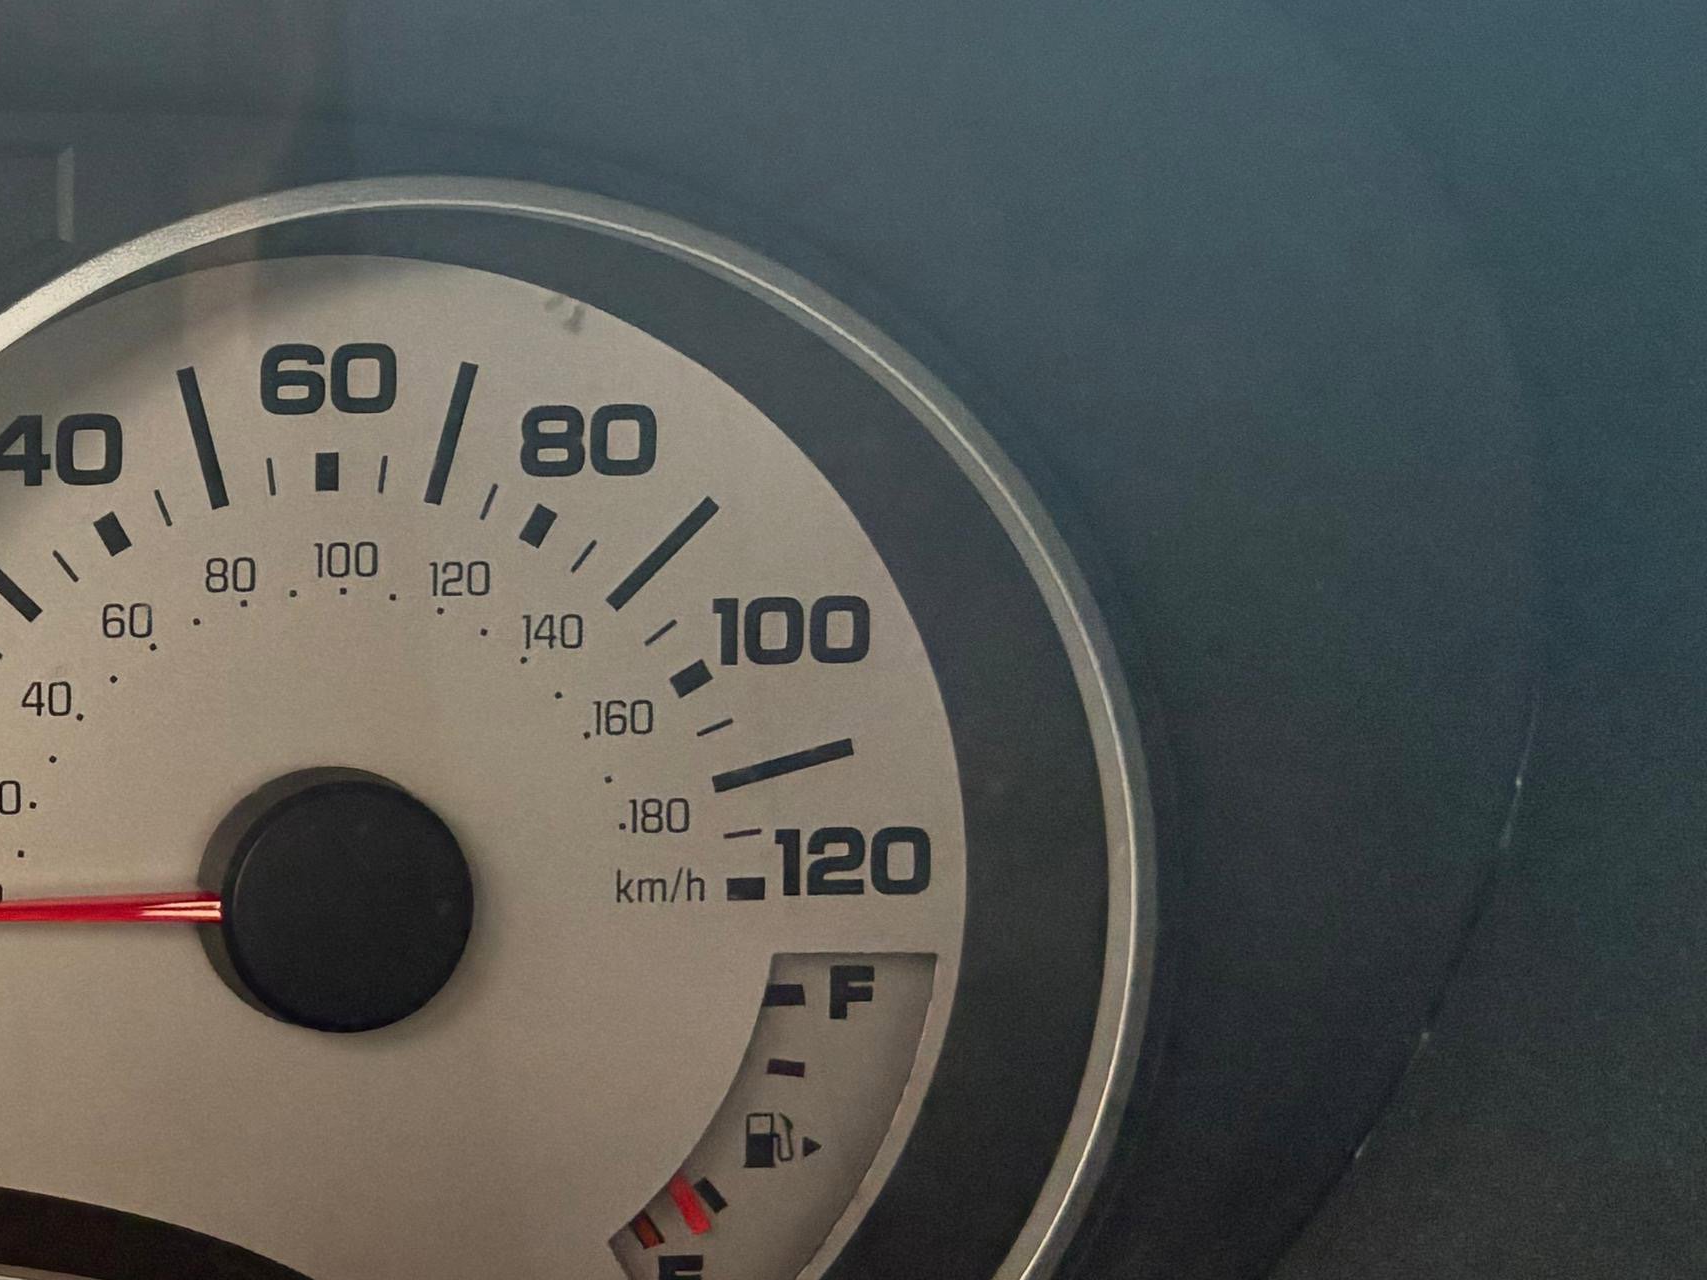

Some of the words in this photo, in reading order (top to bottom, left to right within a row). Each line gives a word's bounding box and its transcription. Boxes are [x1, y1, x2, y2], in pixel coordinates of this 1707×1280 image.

[261, 343, 397, 415] 60
[521, 404, 657, 477] 80
[205, 557, 256, 593] 80
[315, 542, 378, 578] 100
[430, 561, 490, 596] 120
[102, 603, 152, 638] 60
[523, 614, 583, 649] 140
[713, 596, 870, 665] 100
[22, 681, 72, 716] 40
[594, 700, 653, 736] 160
[629, 798, 690, 834] 180
[775, 827, 931, 896] 120
[616, 868, 705, 903] km/h
[830, 965, 874, 1019] F
